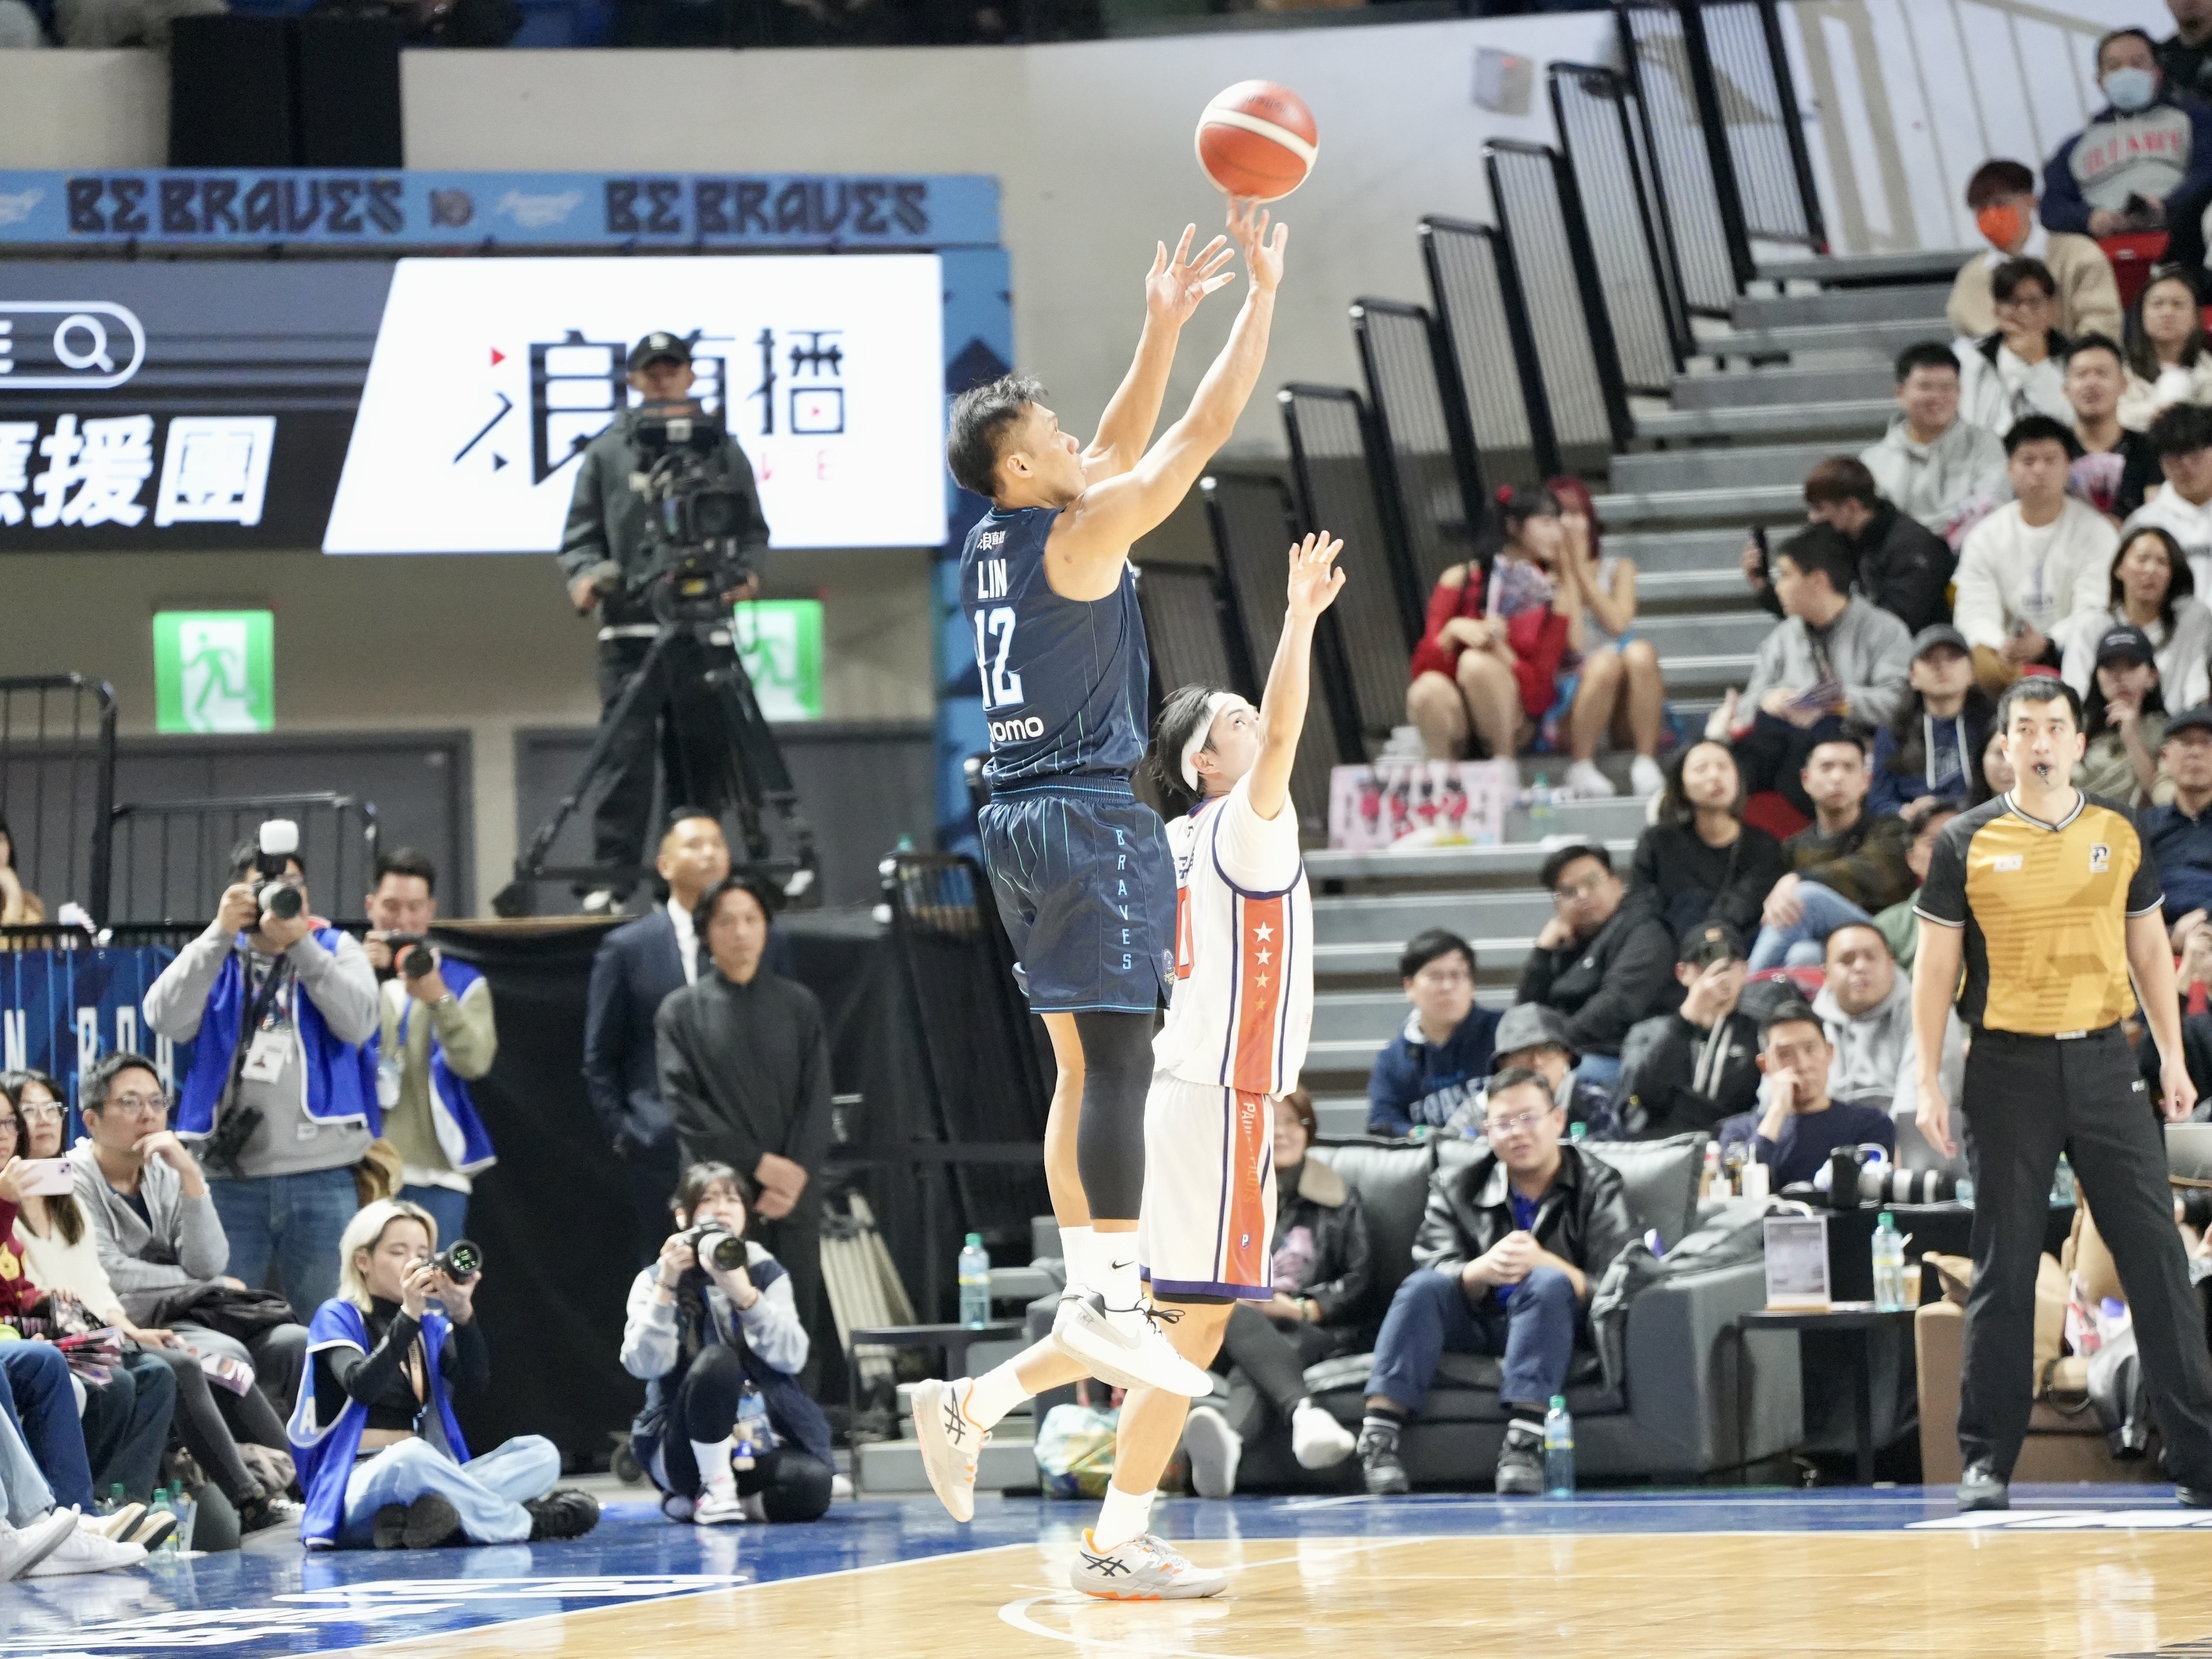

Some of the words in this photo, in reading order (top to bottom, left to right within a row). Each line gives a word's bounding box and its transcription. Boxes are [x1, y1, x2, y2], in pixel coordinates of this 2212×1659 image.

[68, 177, 150, 234] BE
[160, 178, 406, 234] BRAVES
[604, 180, 680, 234] BE
[695, 180, 930, 234] BRAVES
[977, 558, 1007, 599] LIN
[974, 606, 1024, 707] 12
[988, 717, 1044, 742] omo
[1116, 830, 1132, 970] BRAVES
